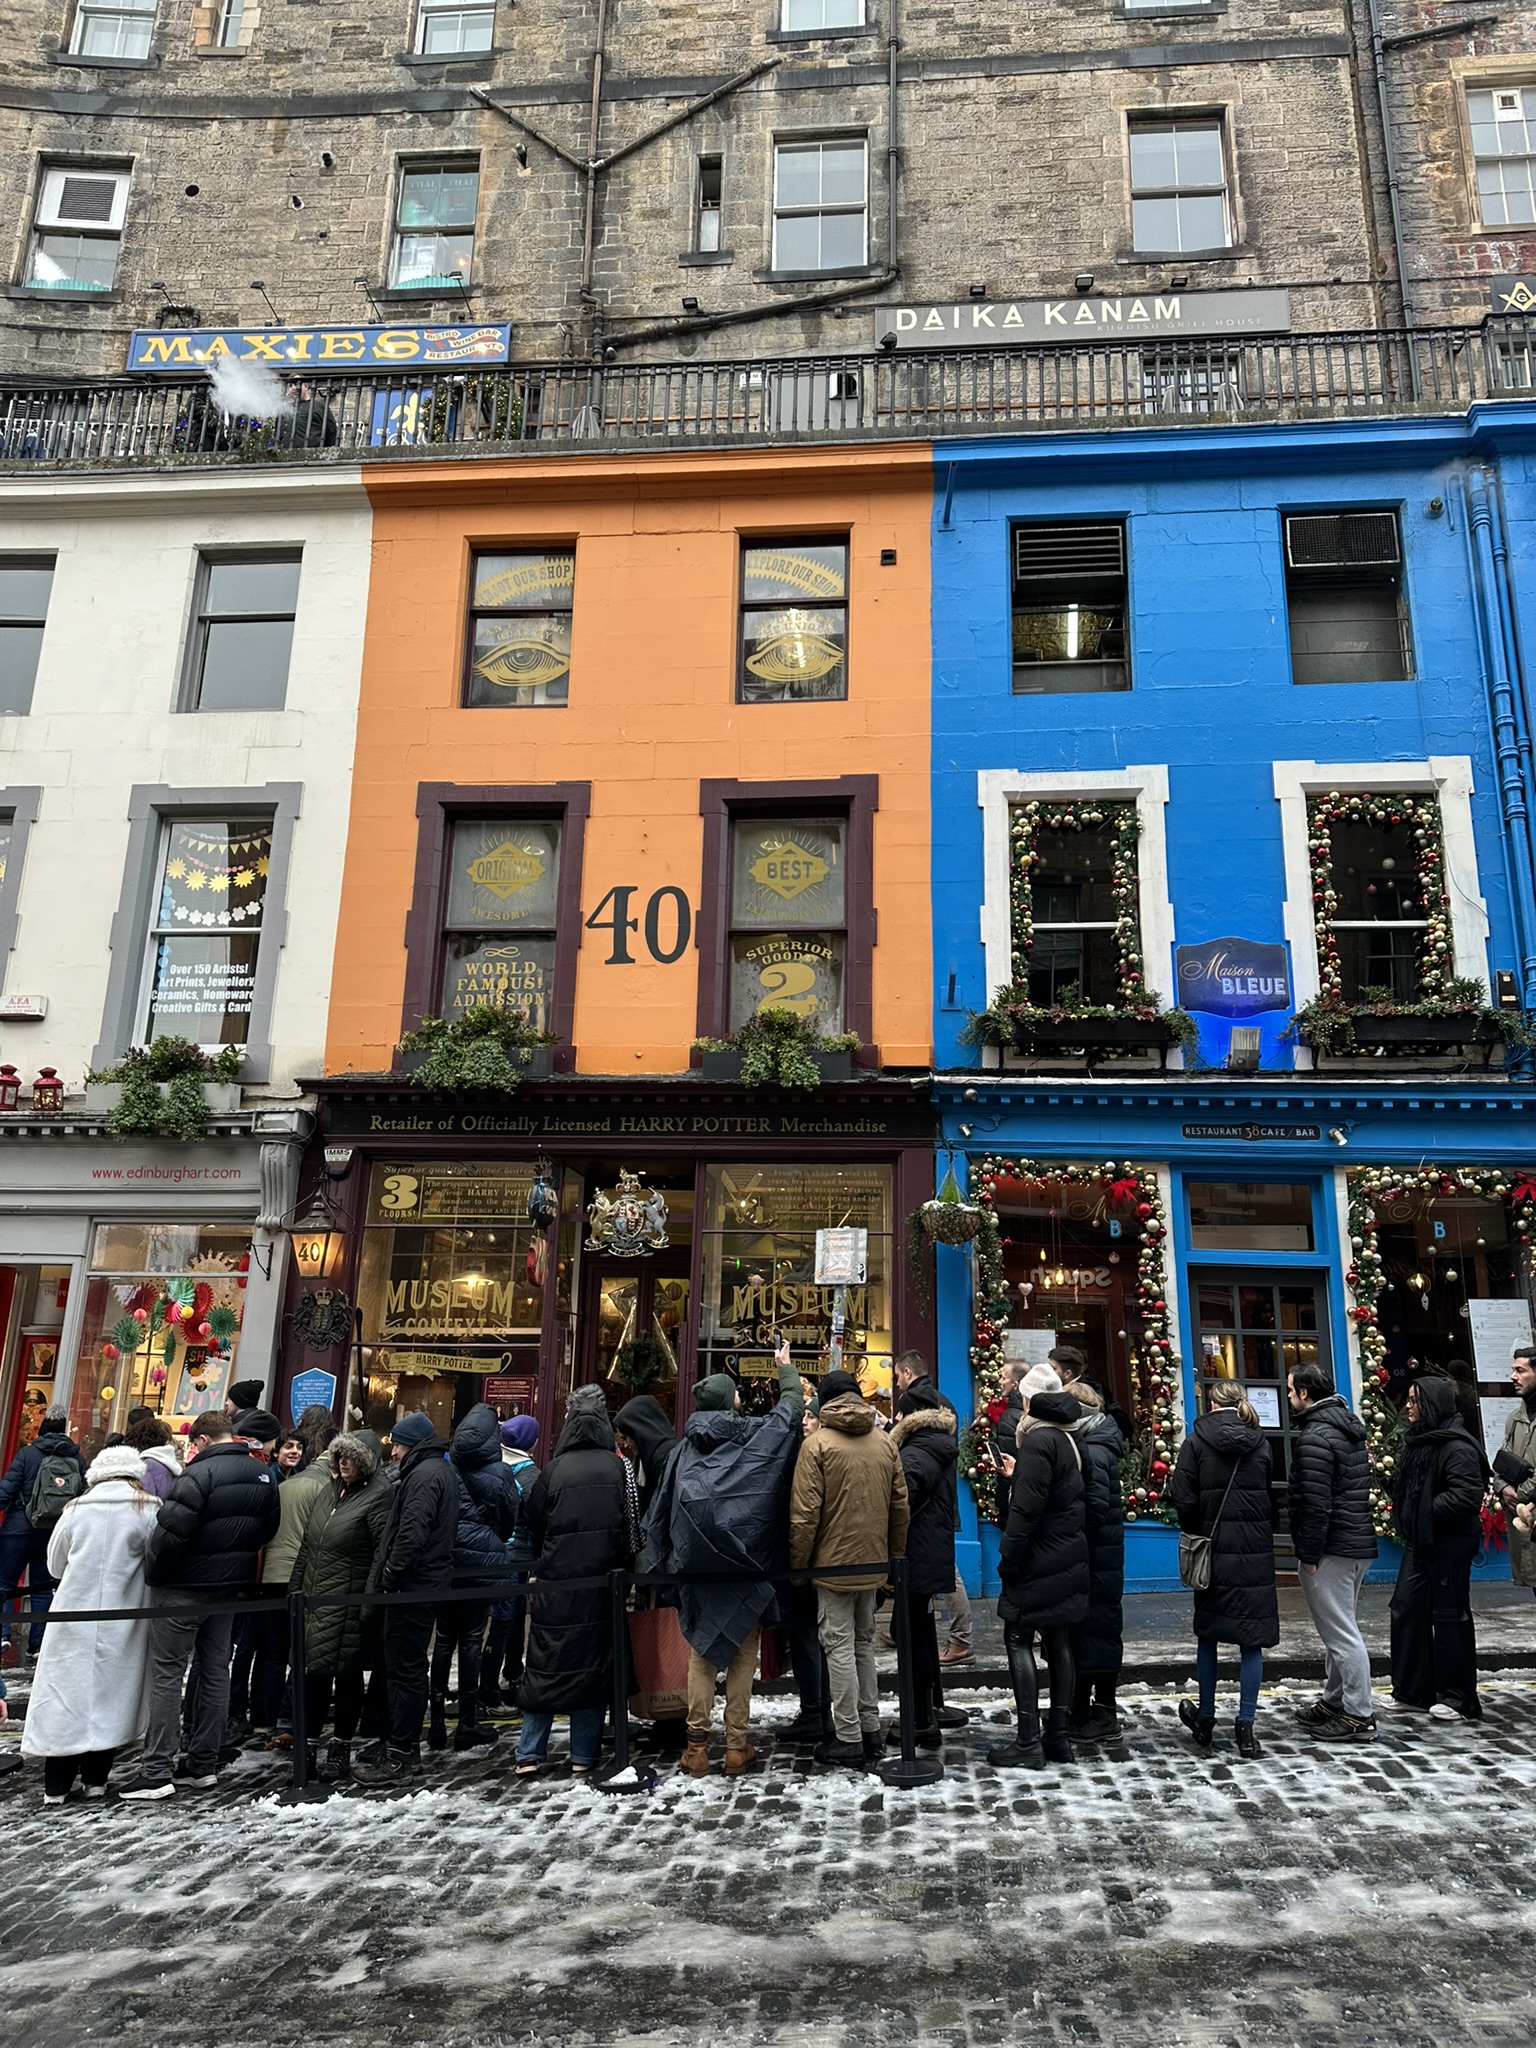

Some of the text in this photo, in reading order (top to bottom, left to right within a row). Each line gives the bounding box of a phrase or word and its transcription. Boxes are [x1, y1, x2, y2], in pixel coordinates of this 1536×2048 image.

[896, 297, 1181, 331] DAIKA KANAM
[1215, 317, 1264, 326] HOUSE
[426, 331, 459, 340] BISTRO
[452, 329, 498, 347] WINE BAR
[138, 330, 421, 363] MAXIES
[513, 569, 537, 587] OUR
[540, 564, 571, 580] SHOP
[746, 554, 839, 595] EXPLORE OUR SHOP
[476, 859, 536, 881] ORIGINAL
[767, 859, 813, 880] BEST
[584, 885, 692, 965] 40
[745, 940, 834, 961] SUPERIOR
[170, 963, 249, 975] Over 150 Artists!
[465, 961, 537, 976] WORLD
[1179, 951, 1255, 983] Maison
[159, 976, 174, 988] Art
[174, 976, 206, 989] Prints,
[456, 976, 544, 992] FAMOUS!
[1222, 977, 1287, 996] BLEUE
[151, 989, 200, 1001] Ceramics,
[453, 992, 546, 1007] ADMISSION
[152, 1002, 193, 1013] Creative
[194, 1001, 217, 1013] Gifts
[218, 1002, 227, 1013] &
[369, 1115, 888, 1136] Retailer of Officially Licensed HARRY POTTER Merchandise
[1185, 1126, 1242, 1136] RESTAURANT
[1245, 1125, 1260, 1139] 38
[1295, 1128, 1316, 1137] BAR
[91, 1165, 242, 1183] www.edinburghart.com
[384, 1165, 426, 1175] Superior
[428, 1166, 463, 1176] quality
[380, 1174, 419, 1210] 3
[424, 1188, 432, 1196] of
[467, 1188, 500, 1197] HARRY
[426, 1180, 441, 1188] The
[442, 1180, 472, 1189] original
[442, 1205, 452, 1214] of
[474, 1198, 483, 1206] to
[486, 1198, 499, 1206] the
[1109, 1219, 1123, 1238] B
[1434, 1220, 1447, 1239] B
[298, 1242, 320, 1262] 40
[44, 1287, 58, 1297] the
[386, 1279, 516, 1318] MUSEUM
[731, 1285, 867, 1326] MUSEUM
[404, 1317, 488, 1337] CONTEXT
[755, 1324, 829, 1345] CONTEX
[415, 1354, 442, 1367] HARRY
[443, 1356, 473, 1370] POTTER
[796, 1360, 826, 1373] POTTER
[649, 1693, 682, 1704] PRIMARK
